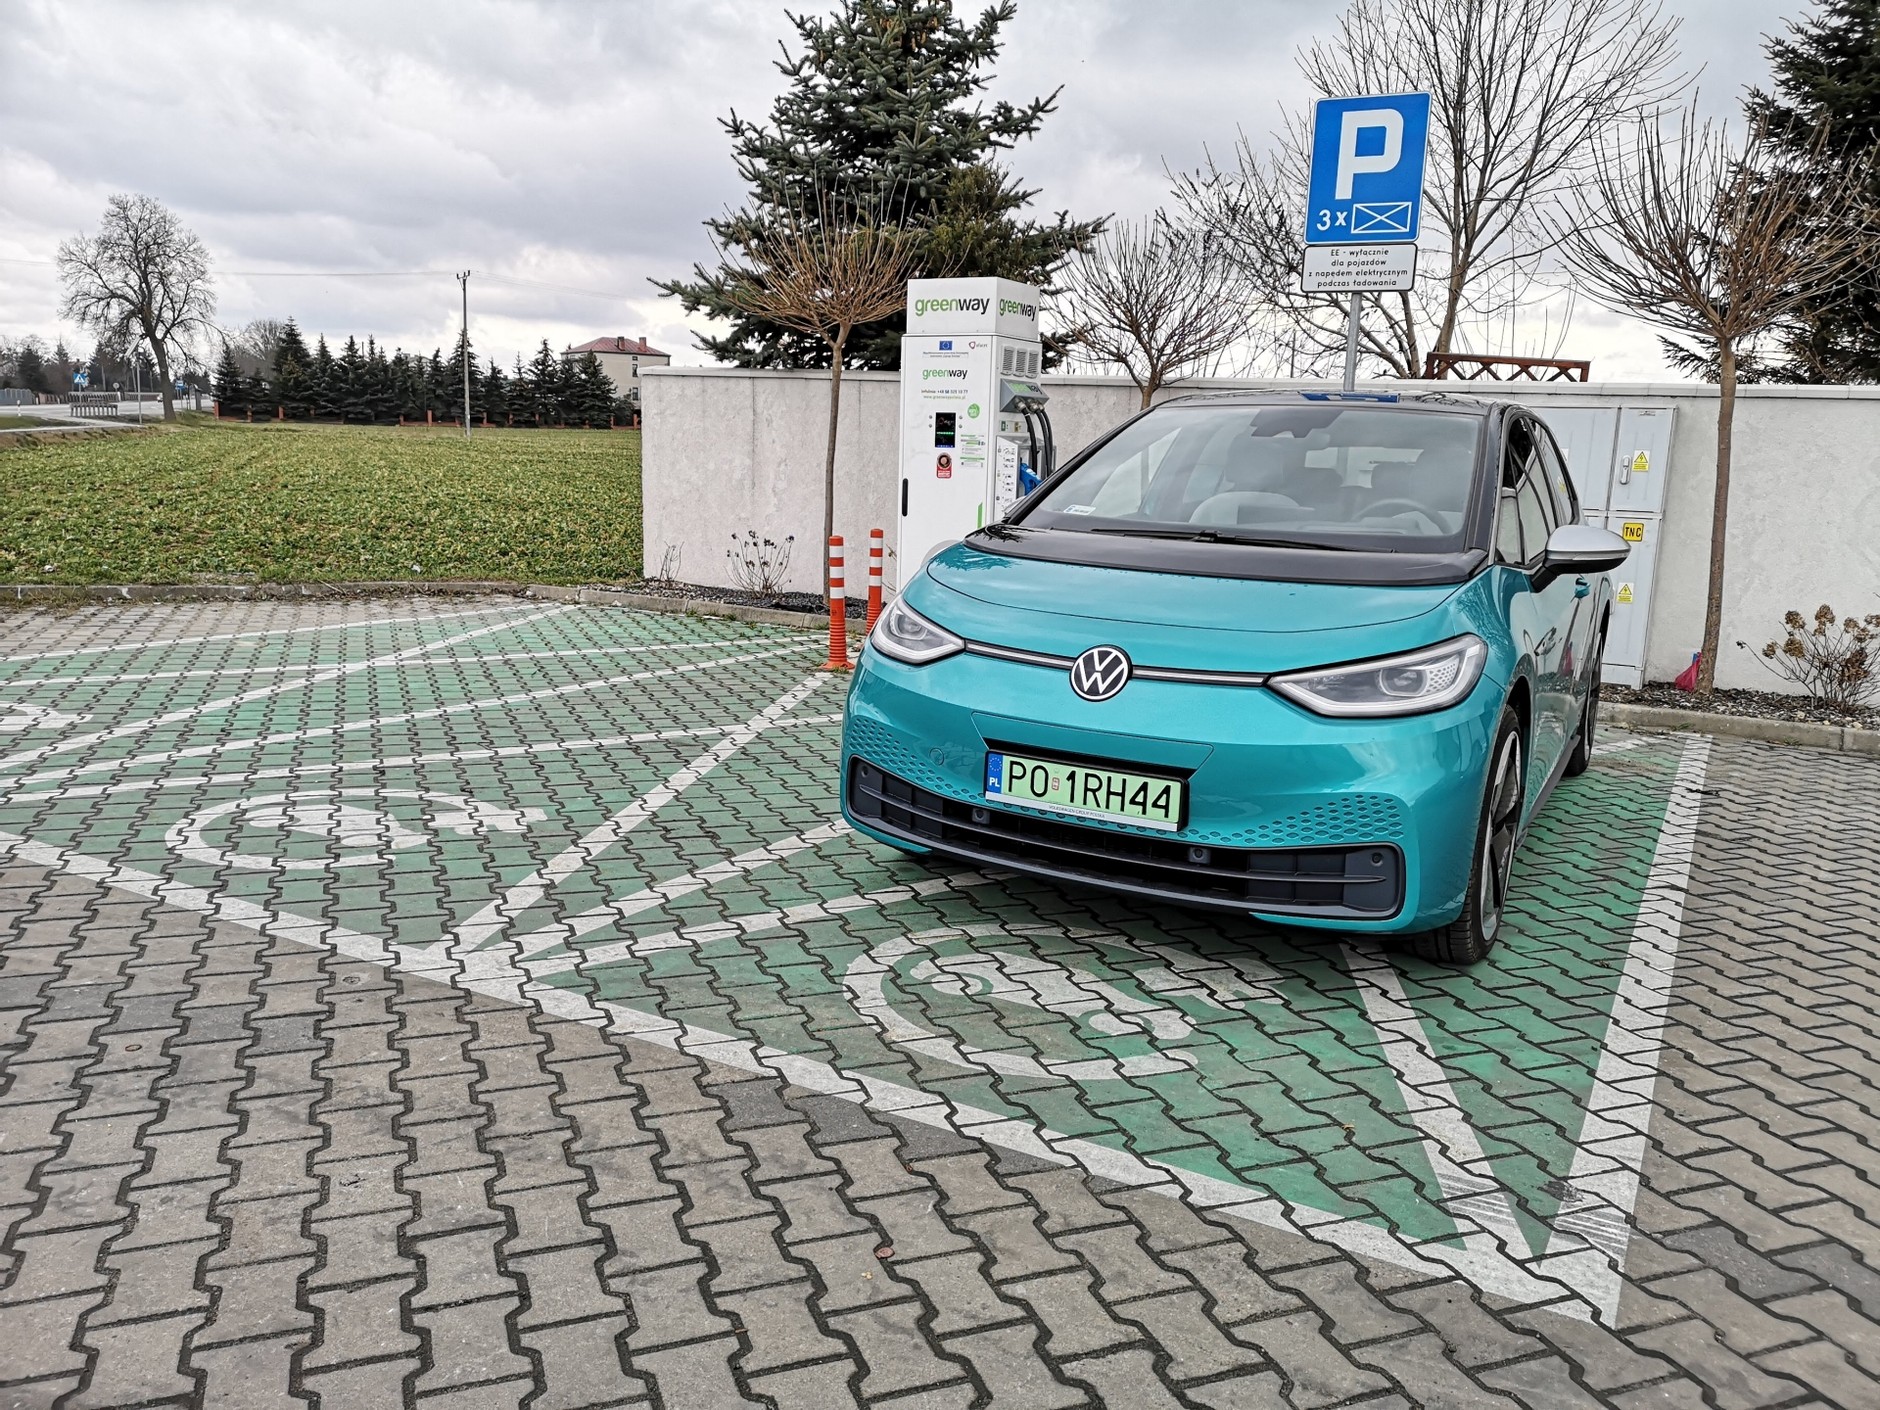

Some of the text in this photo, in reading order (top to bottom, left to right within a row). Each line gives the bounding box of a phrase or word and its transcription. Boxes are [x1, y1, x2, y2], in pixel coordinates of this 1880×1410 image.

[1335, 108, 1404, 200] P
[1330, 249, 1340, 257] EE
[1349, 248, 1389, 258] wyłącznie
[1331, 258, 1387, 268] dla pojazdów
[1355, 269, 1408, 278] elektrycznym
[1317, 279, 1397, 289] podczas ładowania
[915, 298, 990, 317] greenway
[999, 298, 1037, 322] greenway
[922, 369, 968, 380] greenway
[989, 777, 1000, 788] PL
[1008, 760, 1172, 819] PO 1RH44
